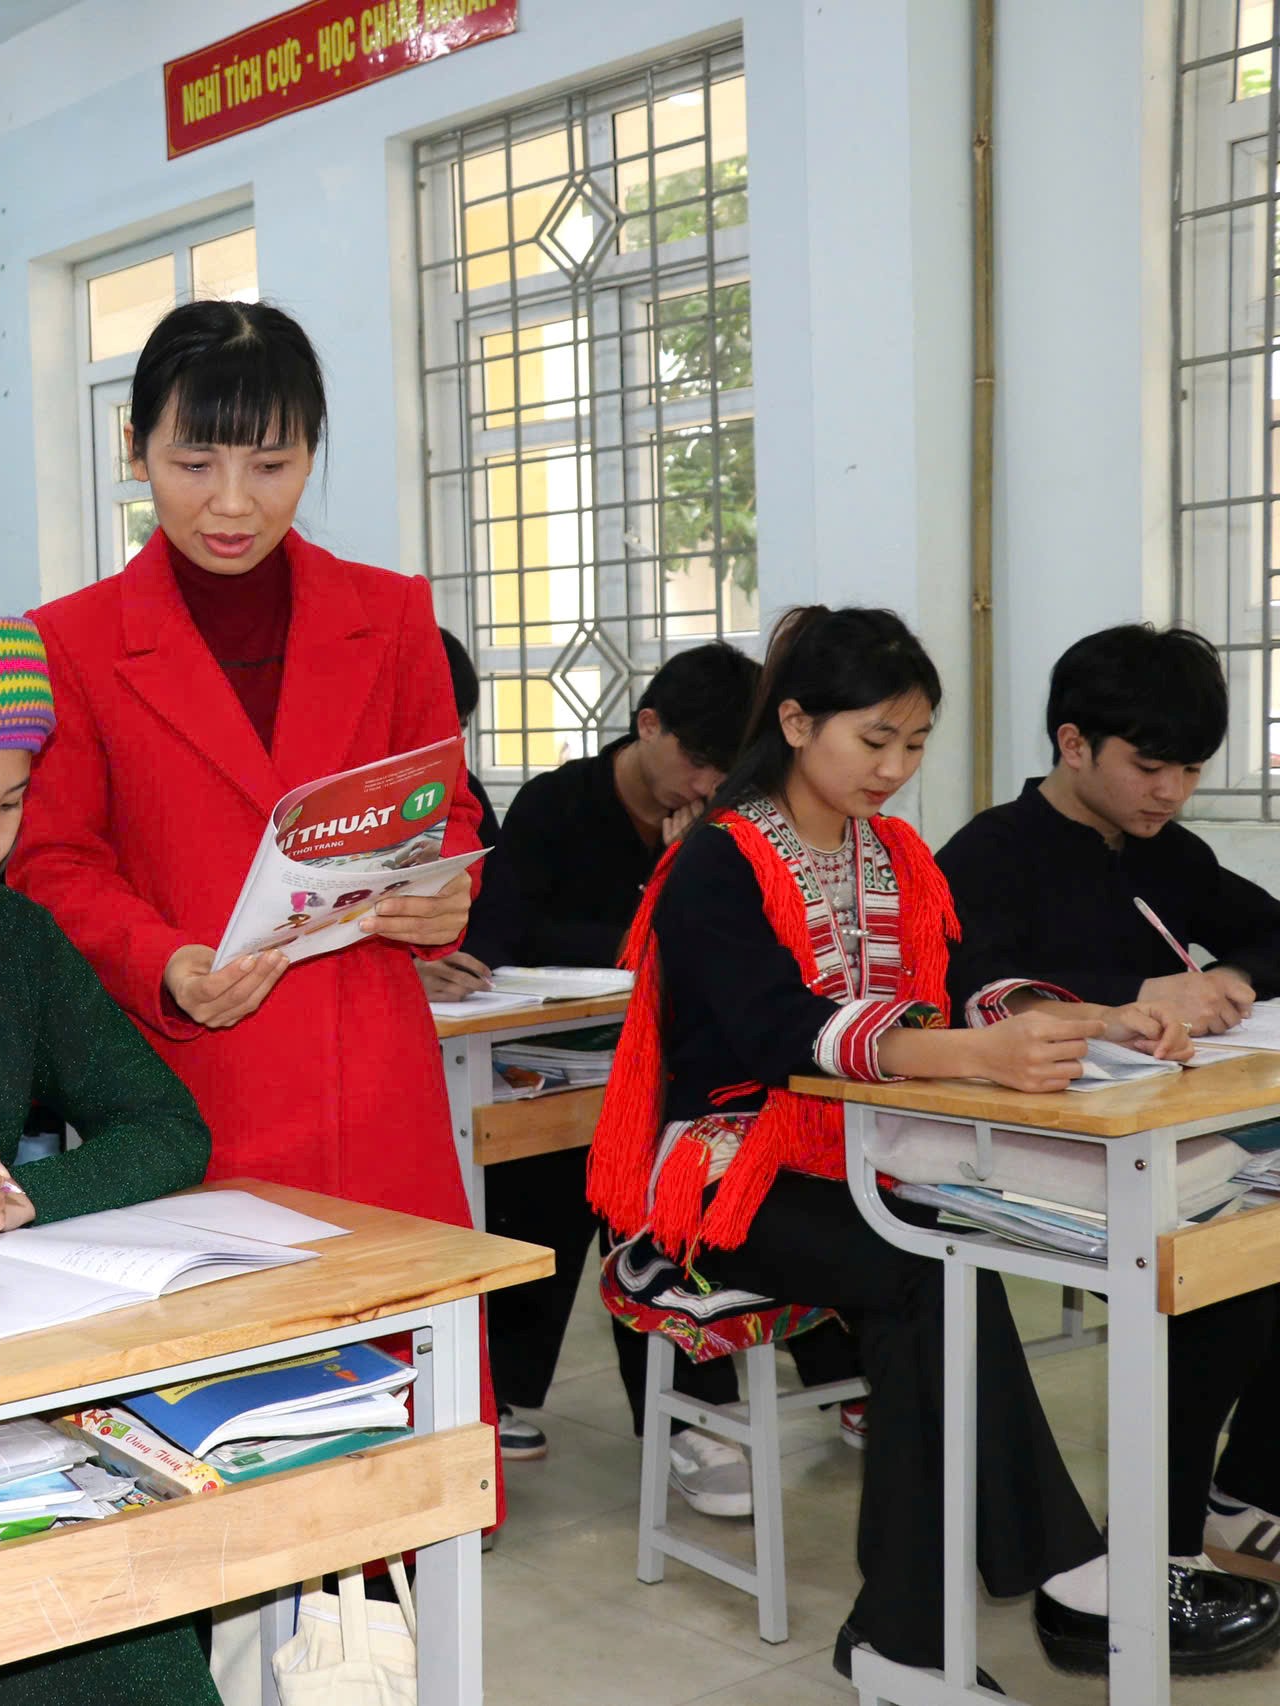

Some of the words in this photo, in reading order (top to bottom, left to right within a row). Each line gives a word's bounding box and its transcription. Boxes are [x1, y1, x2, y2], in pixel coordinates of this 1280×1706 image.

[224, 55, 263, 109] TÍCH
[266, 37, 302, 96] CỰC
[319, 17, 355, 77] HỌC
[414, 789, 435, 812] 11
[299, 804, 396, 844] THUẬT
[314, 840, 345, 850] TRANG
